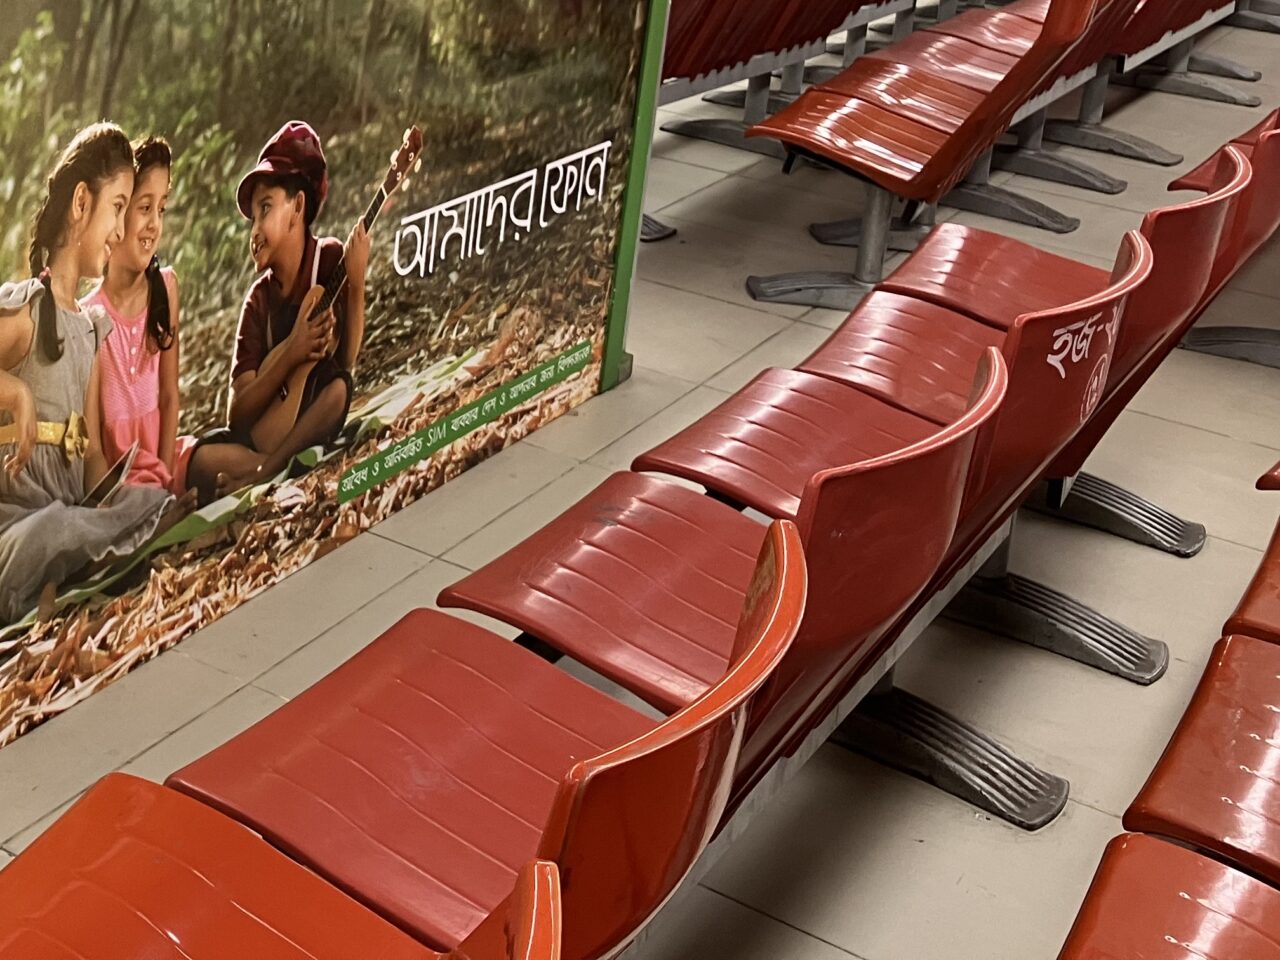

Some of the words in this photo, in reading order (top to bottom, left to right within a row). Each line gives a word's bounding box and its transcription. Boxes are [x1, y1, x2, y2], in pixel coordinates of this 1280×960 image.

[393, 168, 538, 278] আমাদের
[539, 140, 612, 228] ফোন
[341, 467, 368, 492] অবৈধ
[371, 462, 379, 476] ও
[427, 422, 446, 446] SIM
[482, 397, 497, 416] দেশ
[499, 392, 506, 406] ও
